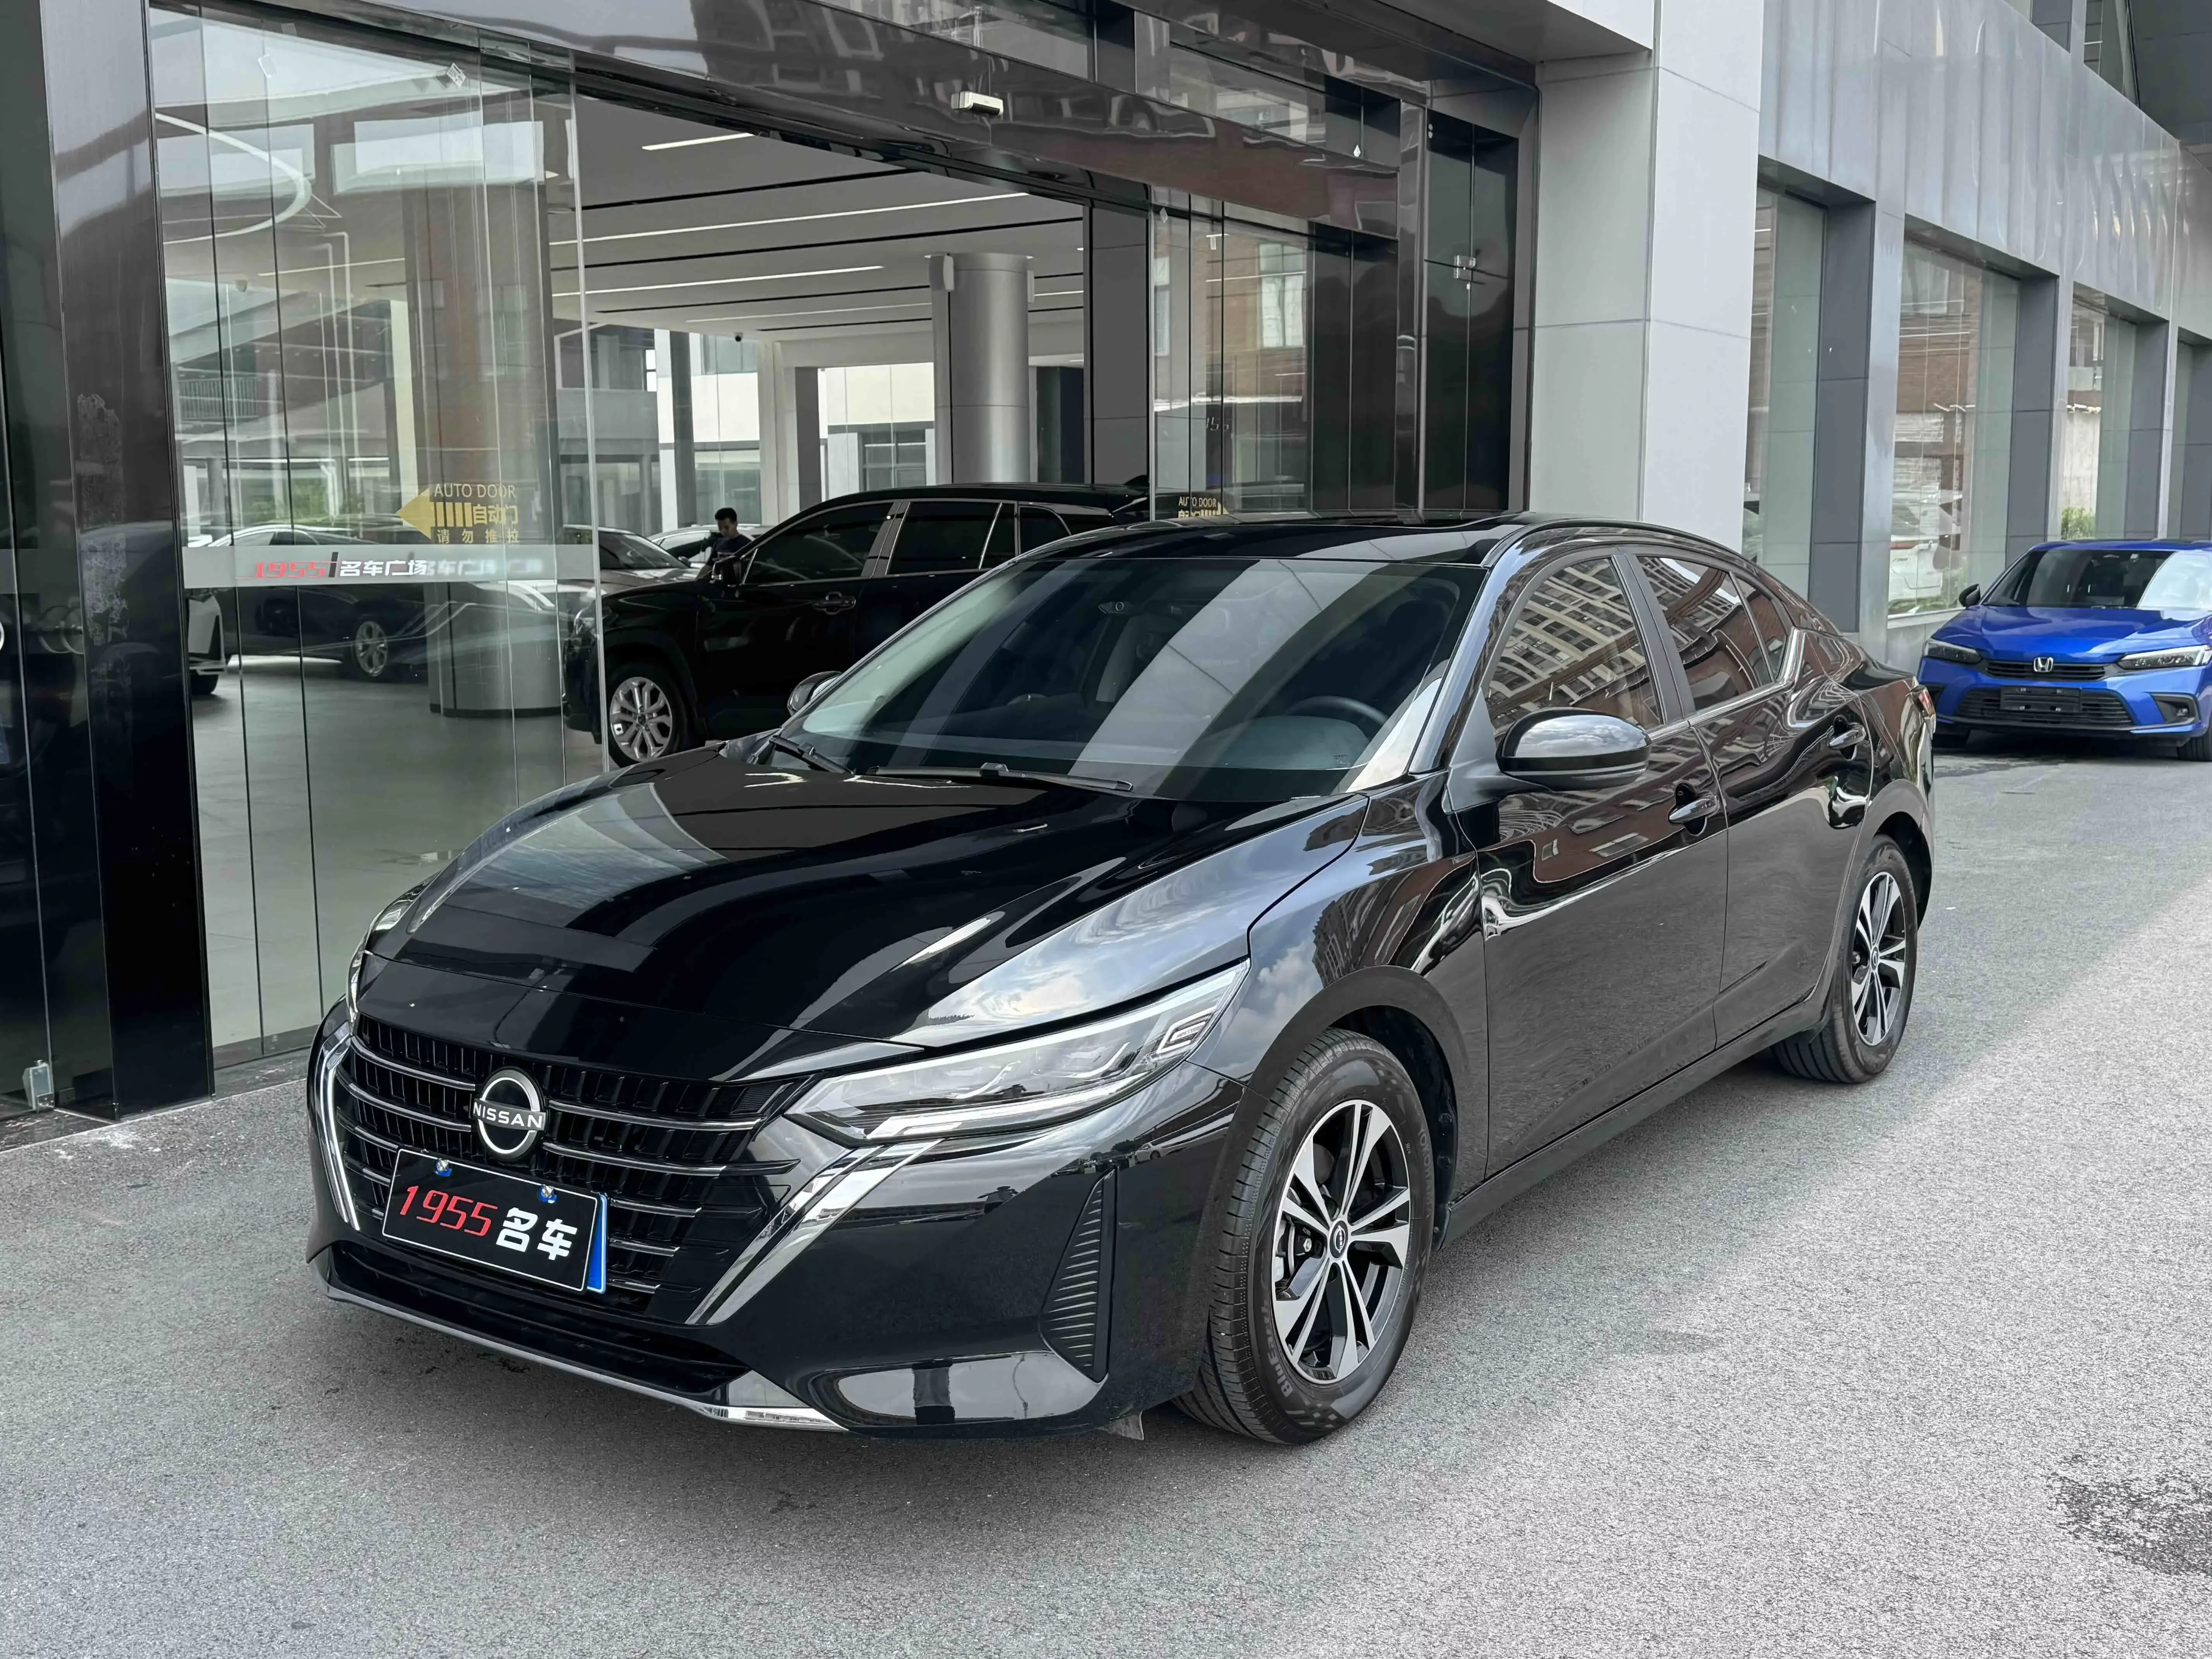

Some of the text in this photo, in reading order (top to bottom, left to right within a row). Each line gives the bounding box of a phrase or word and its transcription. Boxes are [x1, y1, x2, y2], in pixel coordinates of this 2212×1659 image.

[434, 483, 516, 498] AUTO DOOR
[1199, 497, 1216, 507] DOOR
[473, 504, 519, 525] 自动门
[255, 560, 426, 579] 1955 名车广场
[473, 1102, 542, 1128] NISSAN
[400, 1185, 578, 1261] 1955 名车
